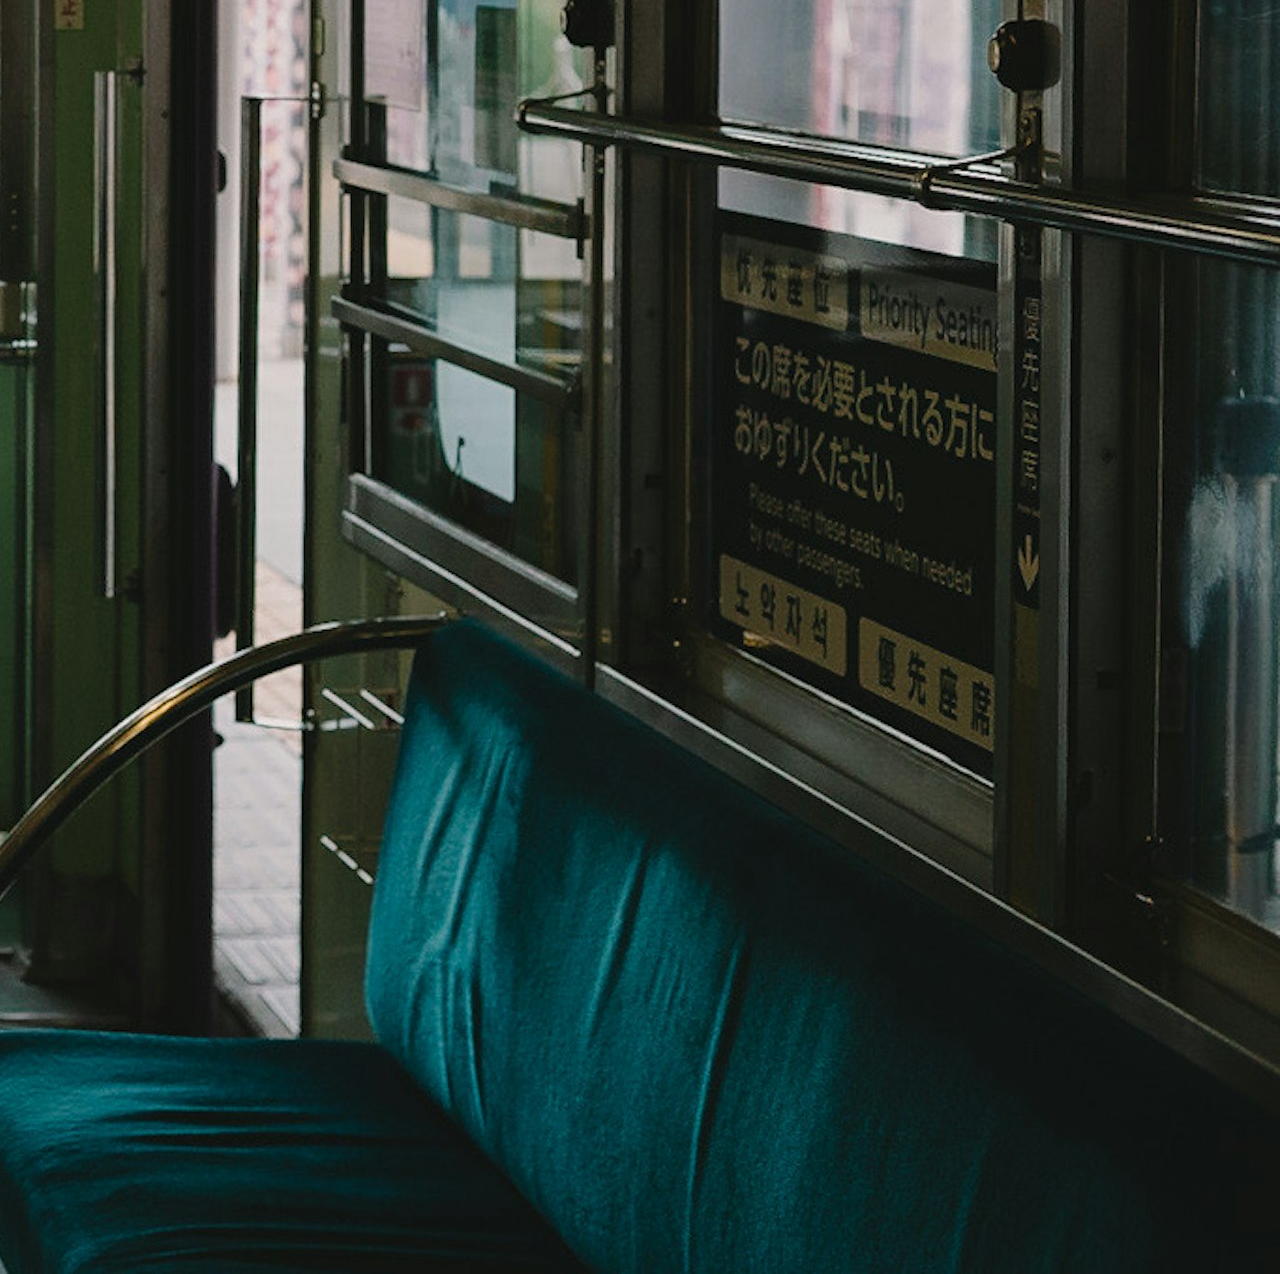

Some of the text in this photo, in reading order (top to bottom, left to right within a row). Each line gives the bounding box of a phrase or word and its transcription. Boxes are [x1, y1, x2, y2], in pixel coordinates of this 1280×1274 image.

[868, 282, 929, 349] Priority
[734, 336, 995, 462] この席を必要とされる方に
[734, 404, 905, 514] おゆずりください。
[748, 480, 784, 520] Please
[848, 526, 882, 559] seats
[884, 540, 920, 574] when
[921, 556, 974, 597] needed
[796, 544, 865, 590] passengers.
[736, 571, 827, 659] 노약자석
[878, 636, 992, 738] 優先座席
